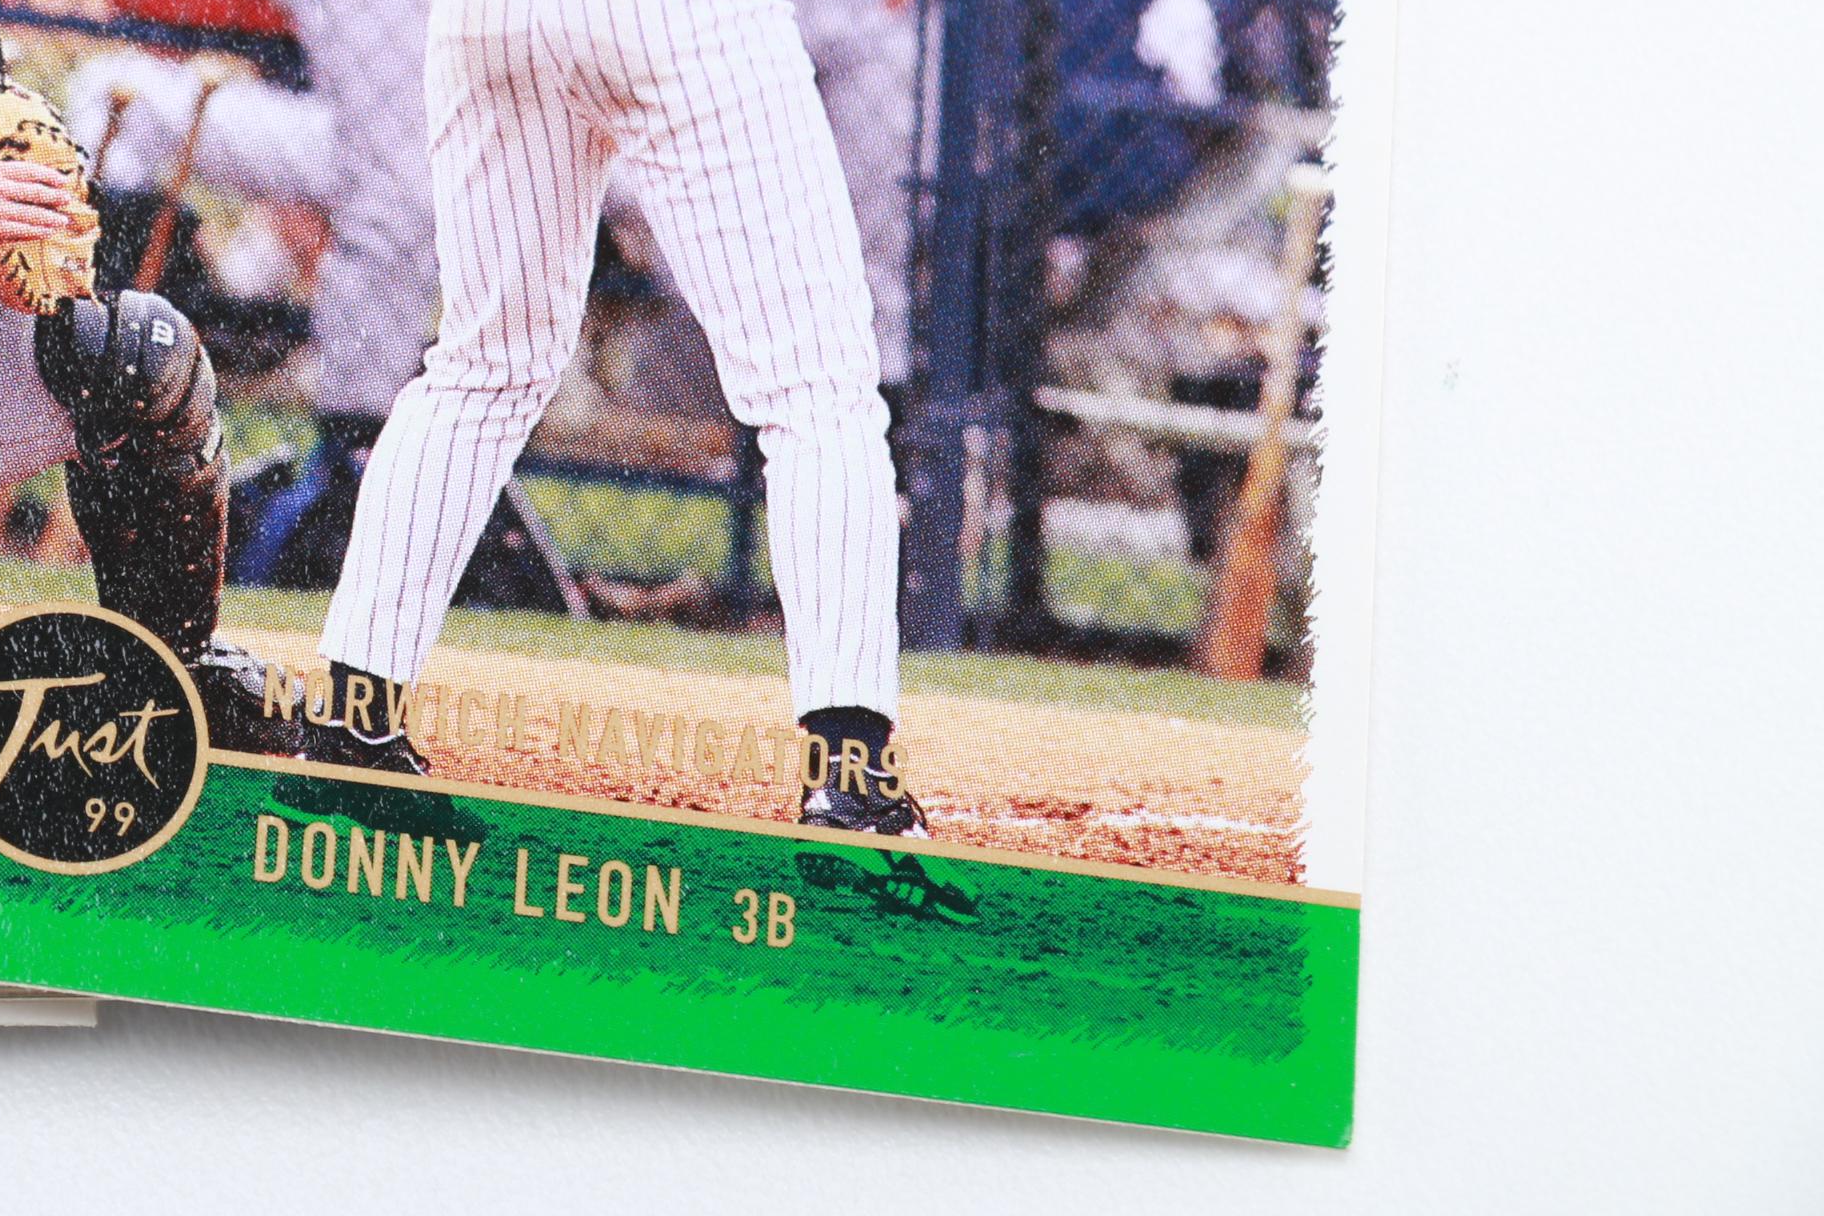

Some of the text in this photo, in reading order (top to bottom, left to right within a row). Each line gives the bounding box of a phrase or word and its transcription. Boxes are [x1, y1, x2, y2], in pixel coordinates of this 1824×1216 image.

[263, 661, 909, 800] NORWICH NAVIGATORS
[84, 797, 136, 837] 99
[254, 814, 797, 949] DONNY LEON 3B
